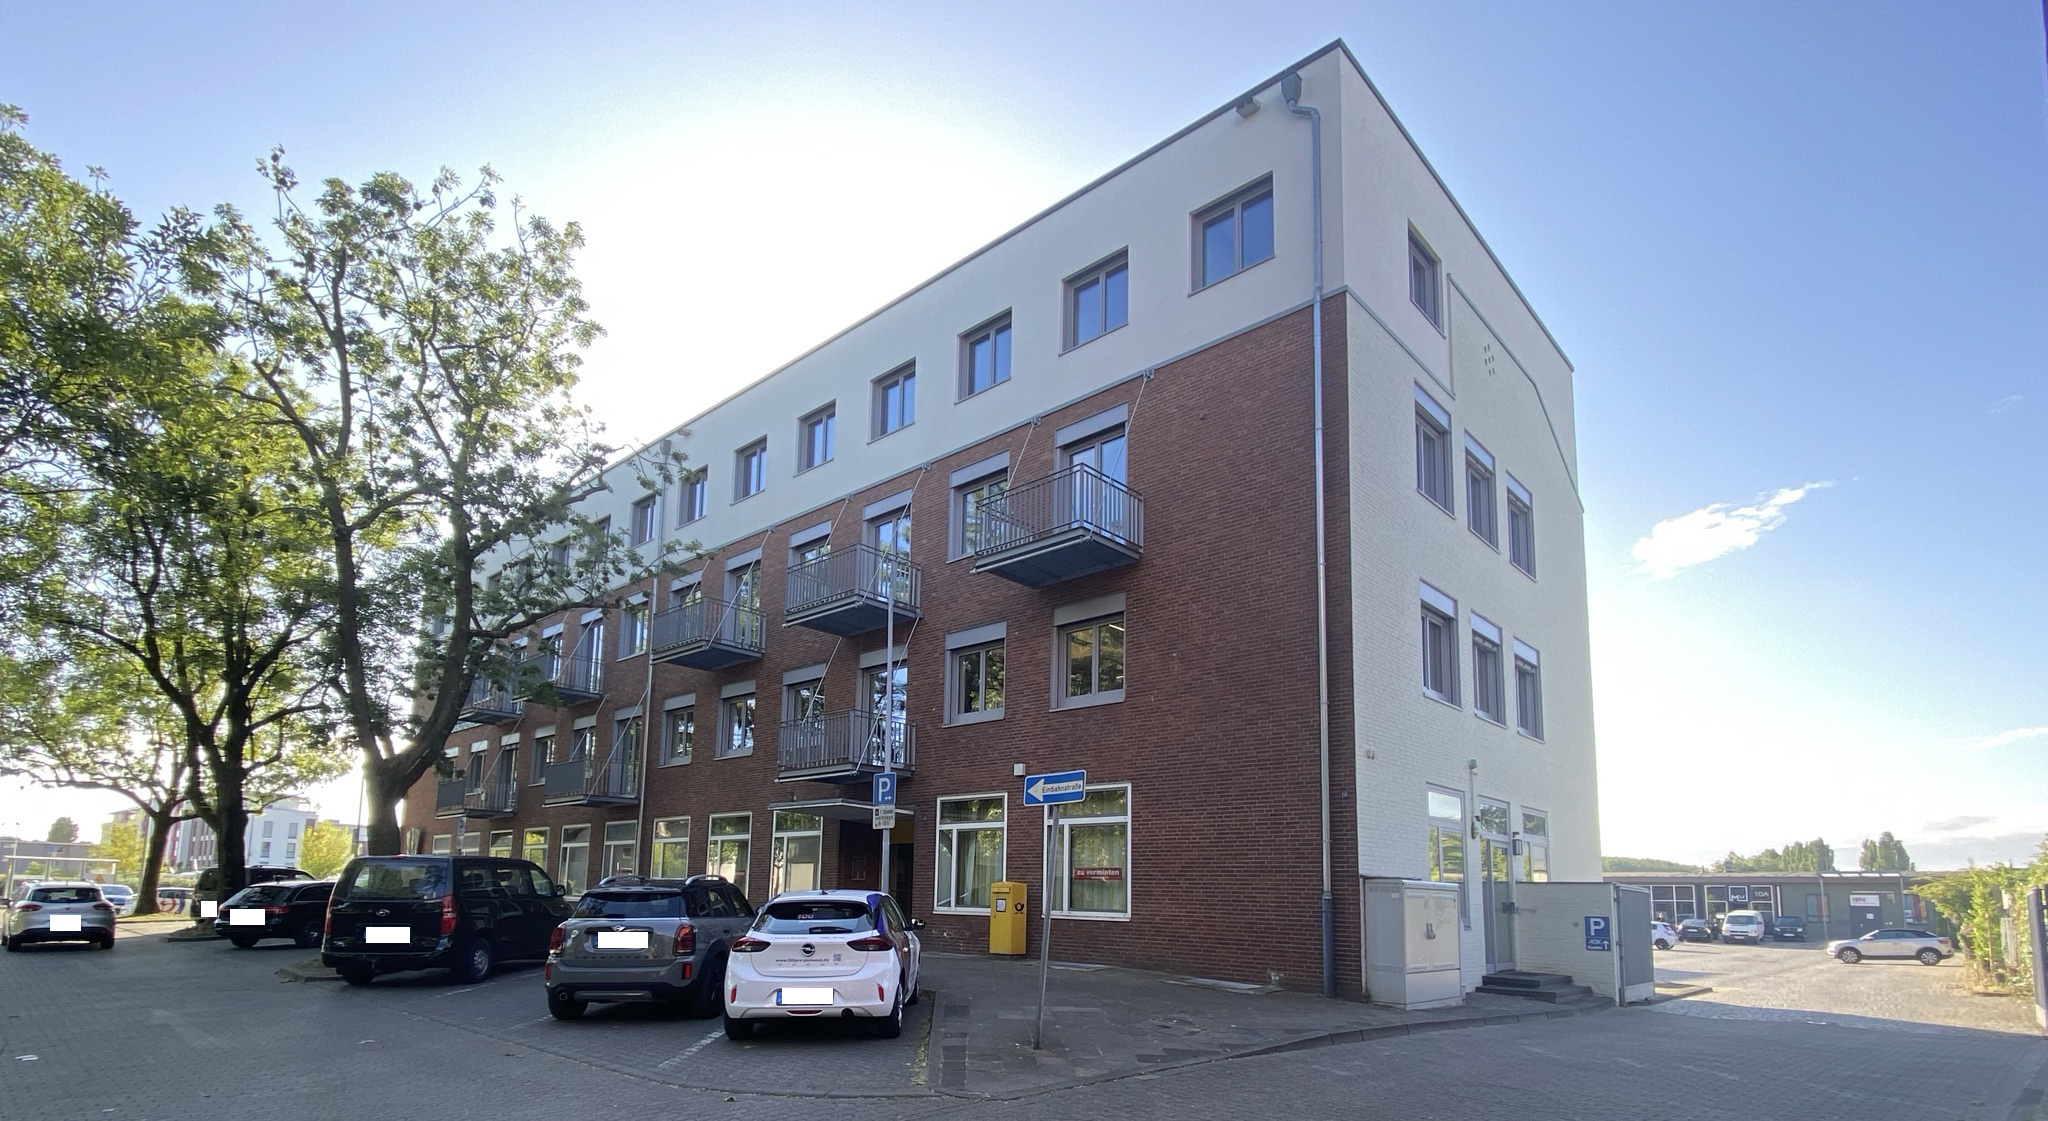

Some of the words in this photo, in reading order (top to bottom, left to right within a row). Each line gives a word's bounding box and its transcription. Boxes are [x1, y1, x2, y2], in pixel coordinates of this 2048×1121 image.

[879, 778, 891, 801] P
[1042, 783, 1081, 793] Einbahnstraße
[1590, 918, 1605, 936] P
